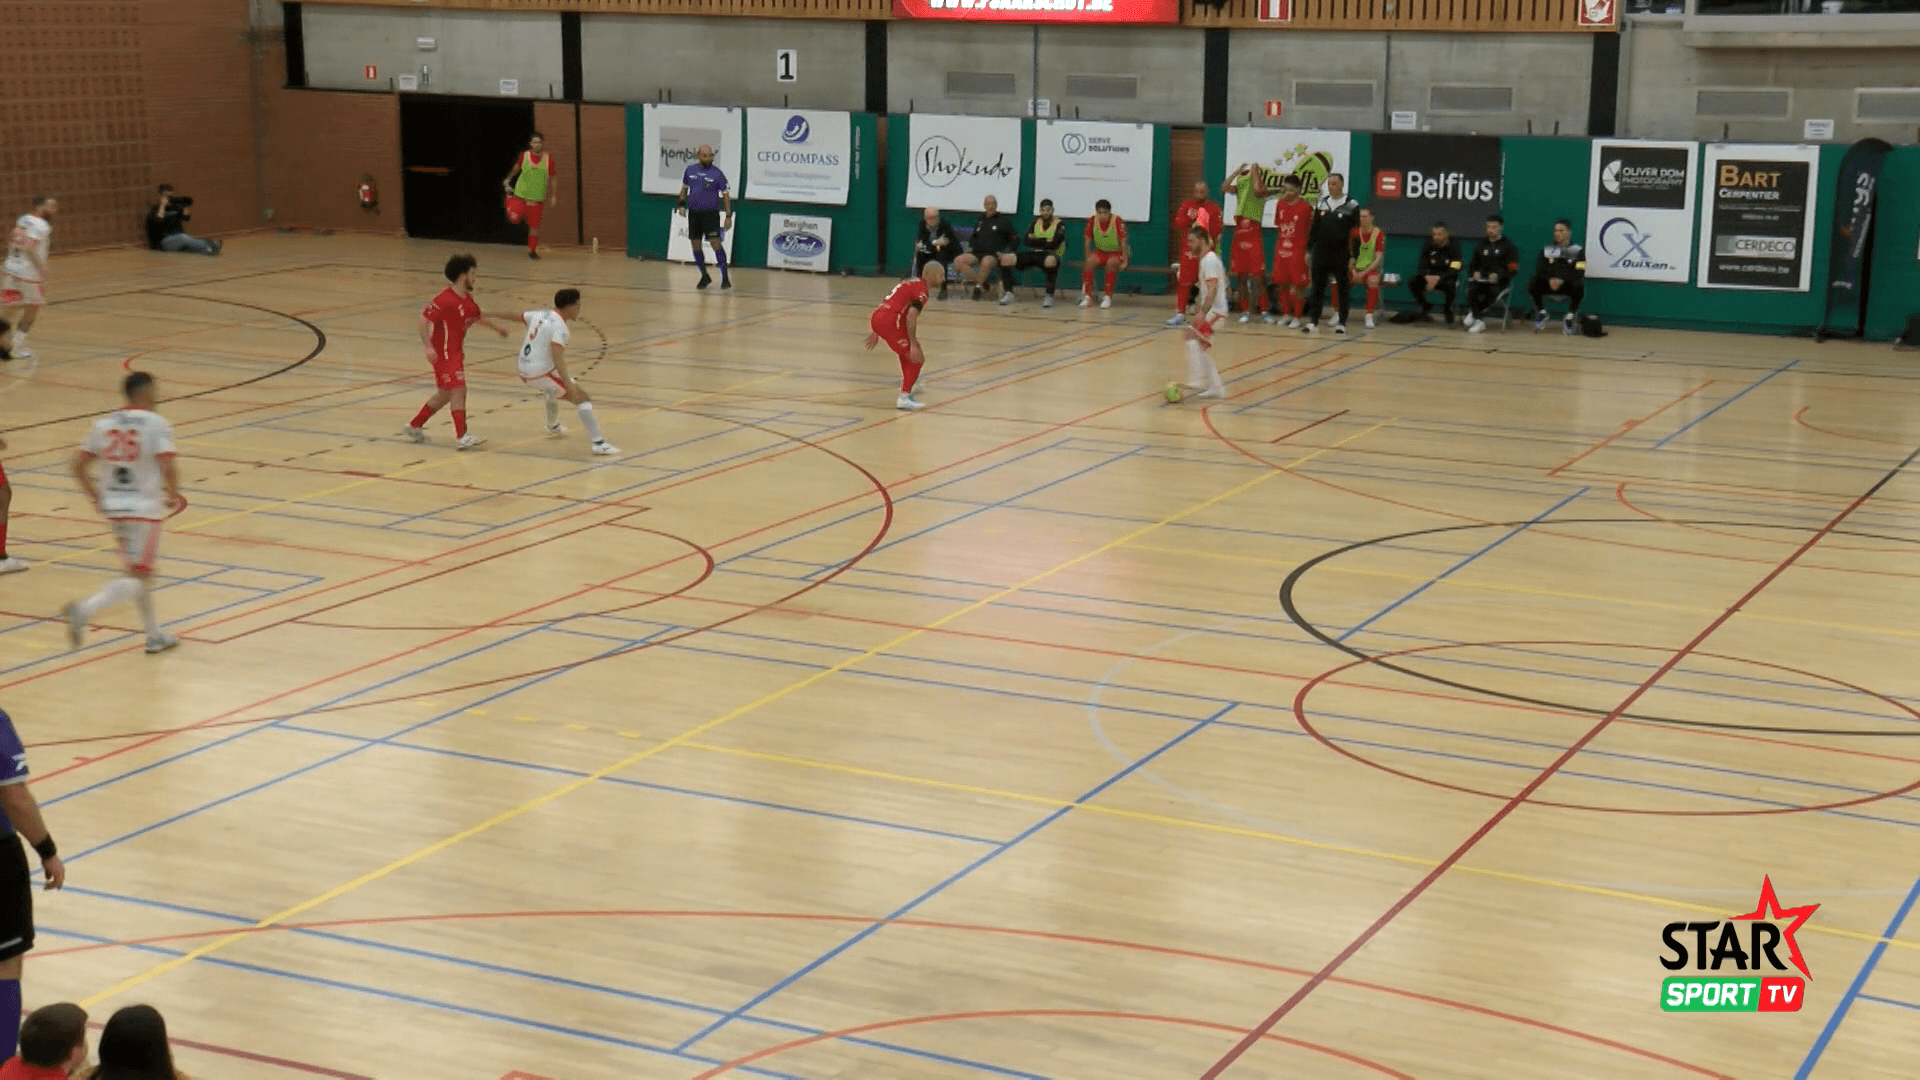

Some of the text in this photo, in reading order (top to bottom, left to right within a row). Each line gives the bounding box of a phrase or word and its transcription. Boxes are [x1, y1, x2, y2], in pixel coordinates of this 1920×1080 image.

[779, 52, 795, 80] 1
[757, 151, 839, 166] CFO COMPASS
[1406, 171, 1494, 202] Belfius
[1735, 239, 1796, 252] CERDECO
